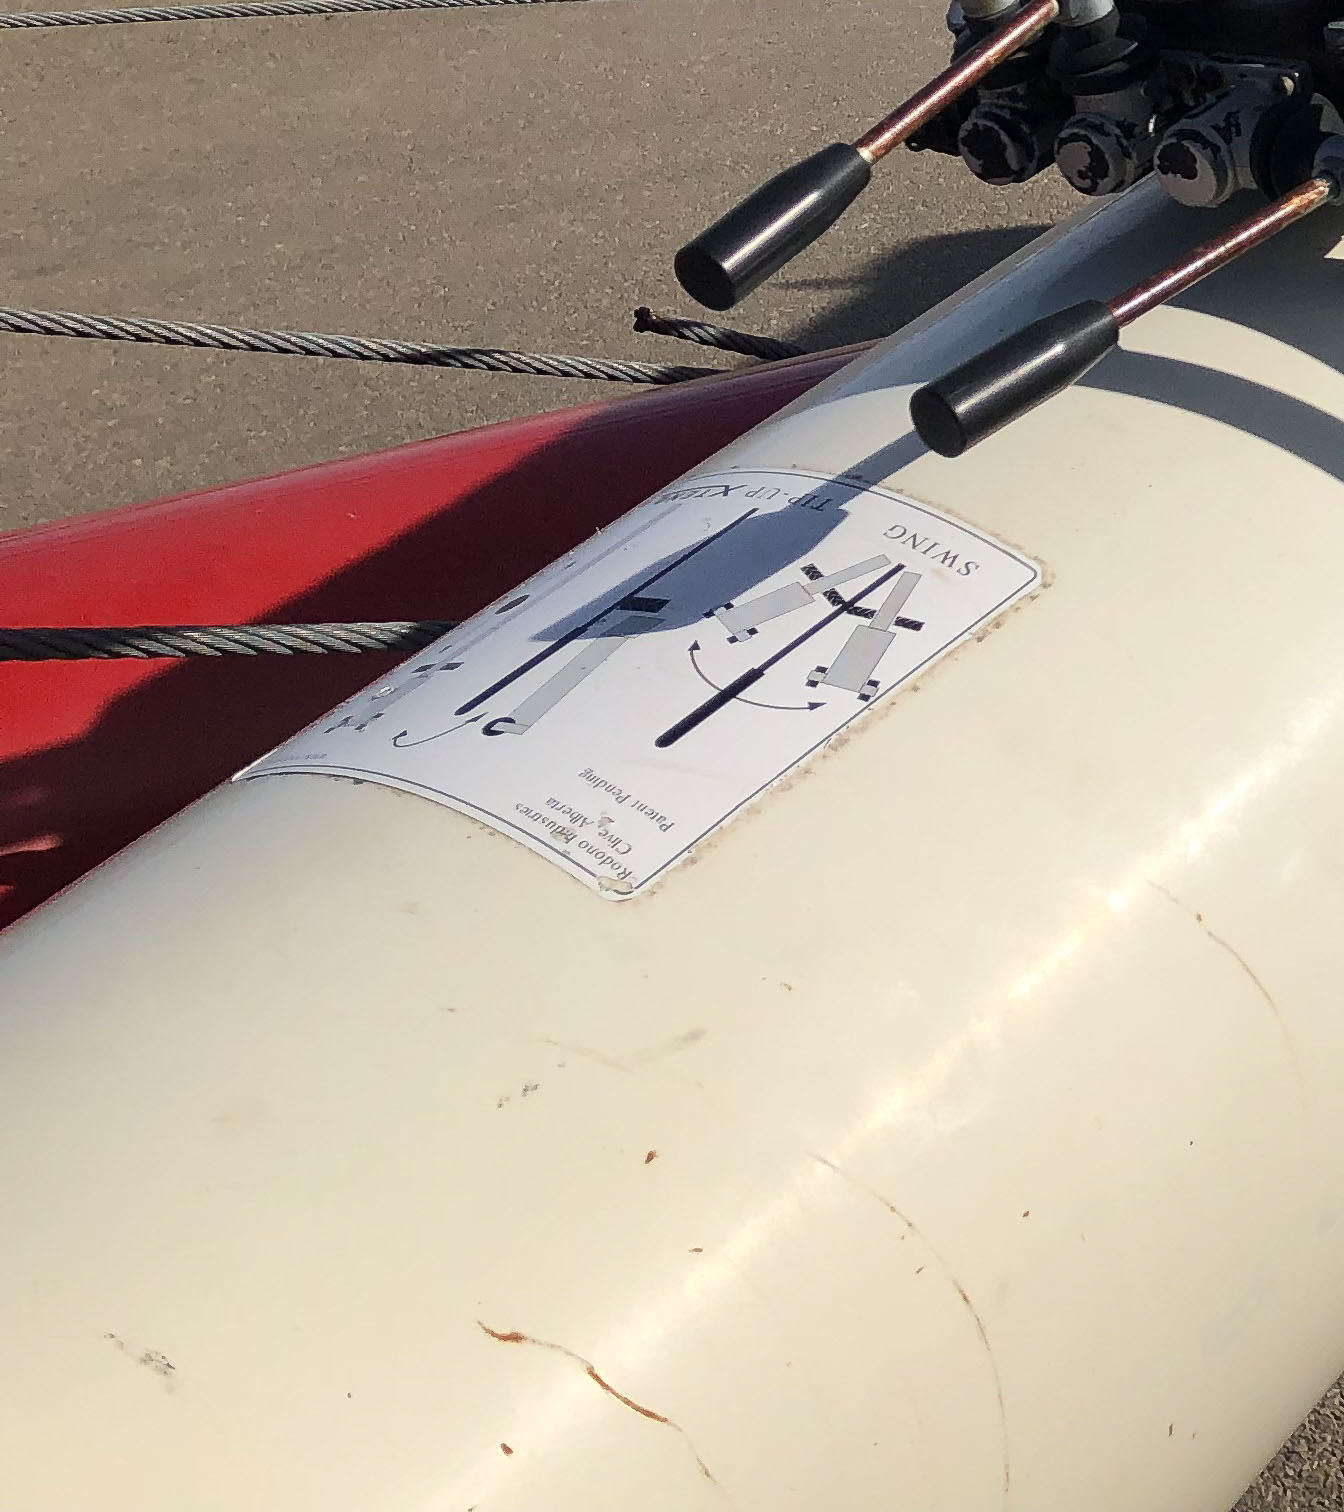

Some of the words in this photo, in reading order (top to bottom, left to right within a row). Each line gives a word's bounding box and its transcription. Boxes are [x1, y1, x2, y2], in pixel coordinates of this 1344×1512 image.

[744, 486, 832, 512] TIP-UP
[882, 523, 979, 578] SWING
[578, 767, 632, 805] Pending
[515, 802, 578, 845] Industries
[544, 797, 594, 829] Alberta
[631, 800, 676, 834] Patent
[578, 839, 634, 882] Rodono
